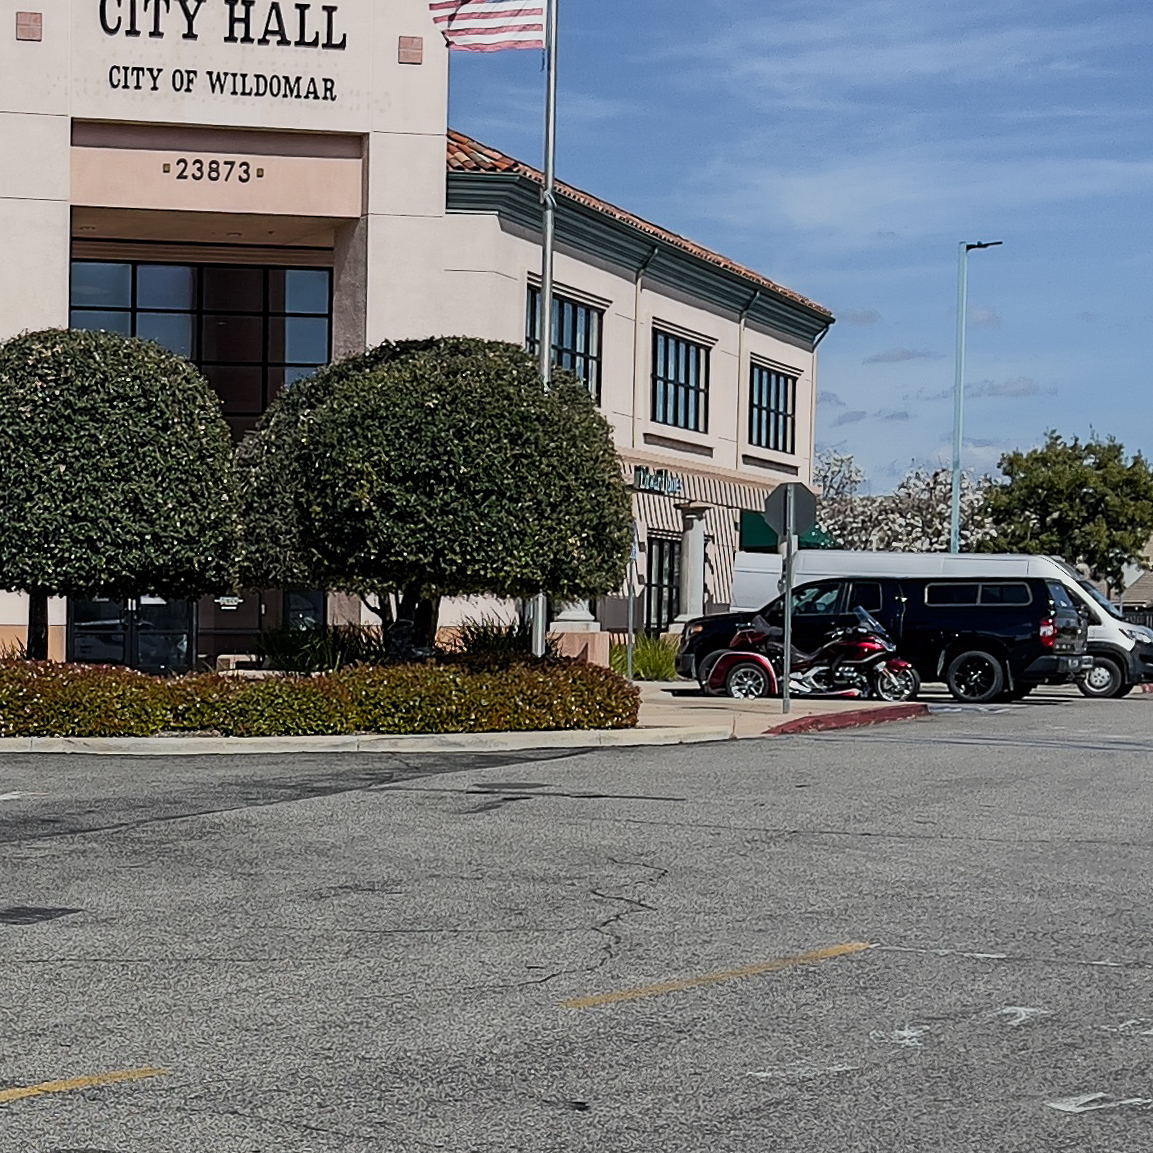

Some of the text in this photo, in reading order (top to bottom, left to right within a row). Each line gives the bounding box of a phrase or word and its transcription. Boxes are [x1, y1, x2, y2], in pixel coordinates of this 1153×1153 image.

[108, 65, 337, 102] CITY OF WILDOMAR
[176, 158, 251, 183] 23873
